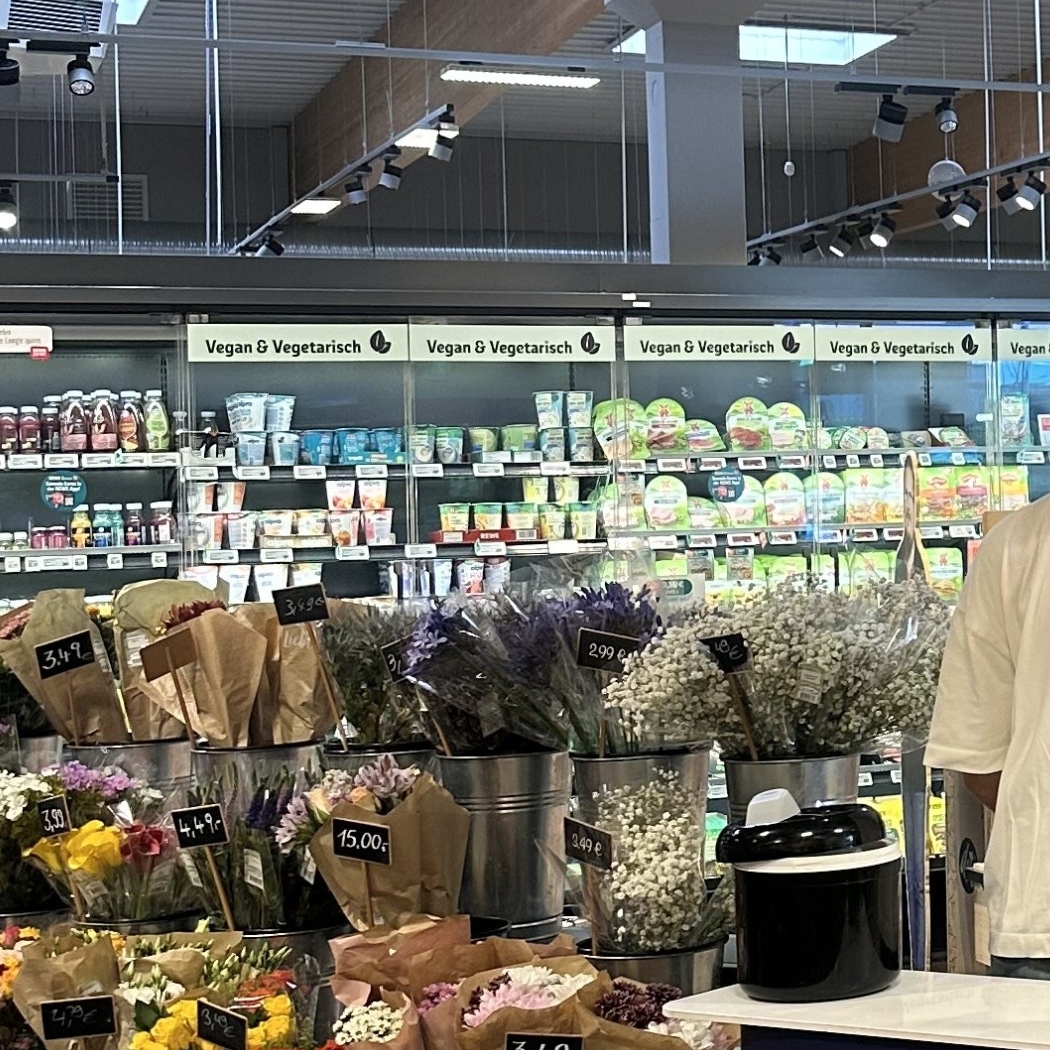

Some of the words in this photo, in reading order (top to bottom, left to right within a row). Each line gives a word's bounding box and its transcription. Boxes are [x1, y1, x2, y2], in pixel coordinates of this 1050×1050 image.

[205, 340, 252, 357] Vegan
[256, 340, 268, 354] &
[272, 340, 362, 357] Vegetarisch
[426, 340, 471, 357] Vegan
[475, 340, 486, 354] &
[490, 340, 572, 357] Vegetarisch
[640, 340, 681, 357] Vegan
[684, 340, 694, 354] &
[698, 340, 774, 357] Vegetarisch
[830, 341, 868, 357] Vegan
[871, 341, 880, 354] &
[884, 341, 954, 357] Vegetarisch
[1010, 342, 1046, 358] Vegan
